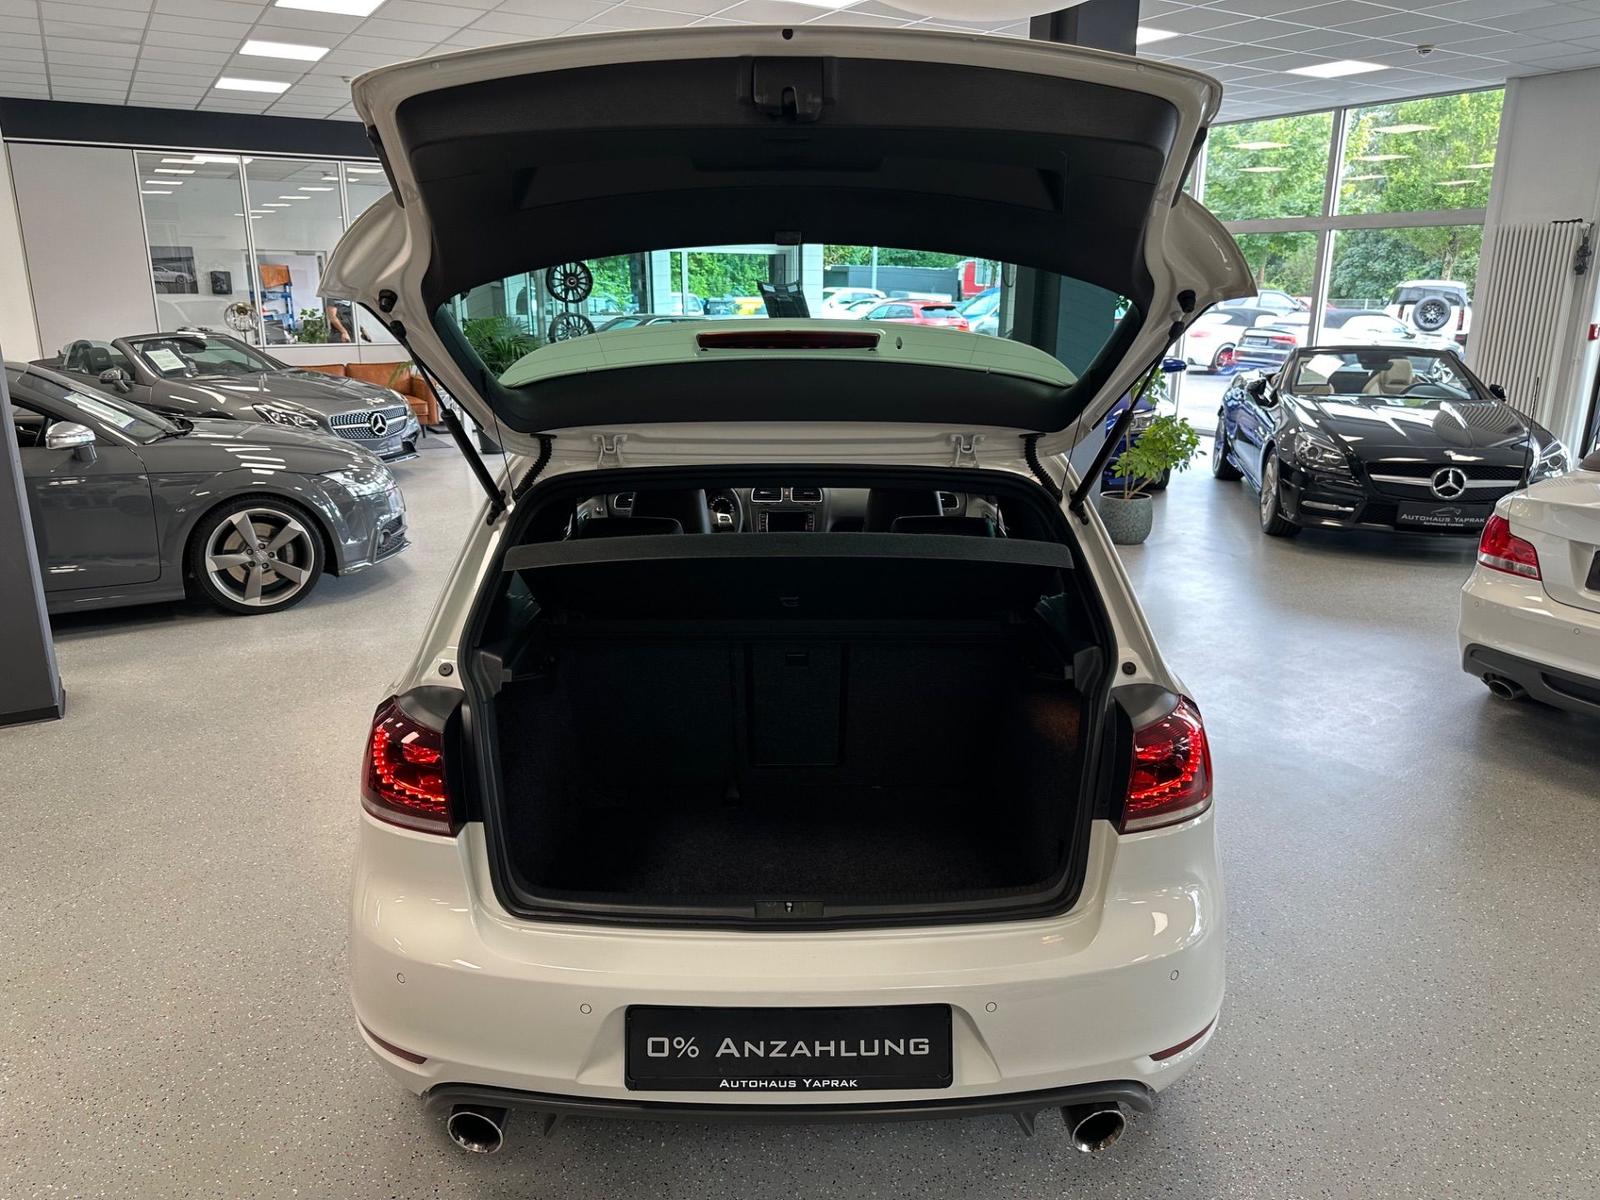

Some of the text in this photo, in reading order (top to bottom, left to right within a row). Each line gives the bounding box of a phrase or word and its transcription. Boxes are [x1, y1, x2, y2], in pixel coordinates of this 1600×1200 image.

[648, 1037, 930, 1058] 0% ANZAHLUNG
[719, 1078, 858, 1088] AUTOHAUS YAPRAK
